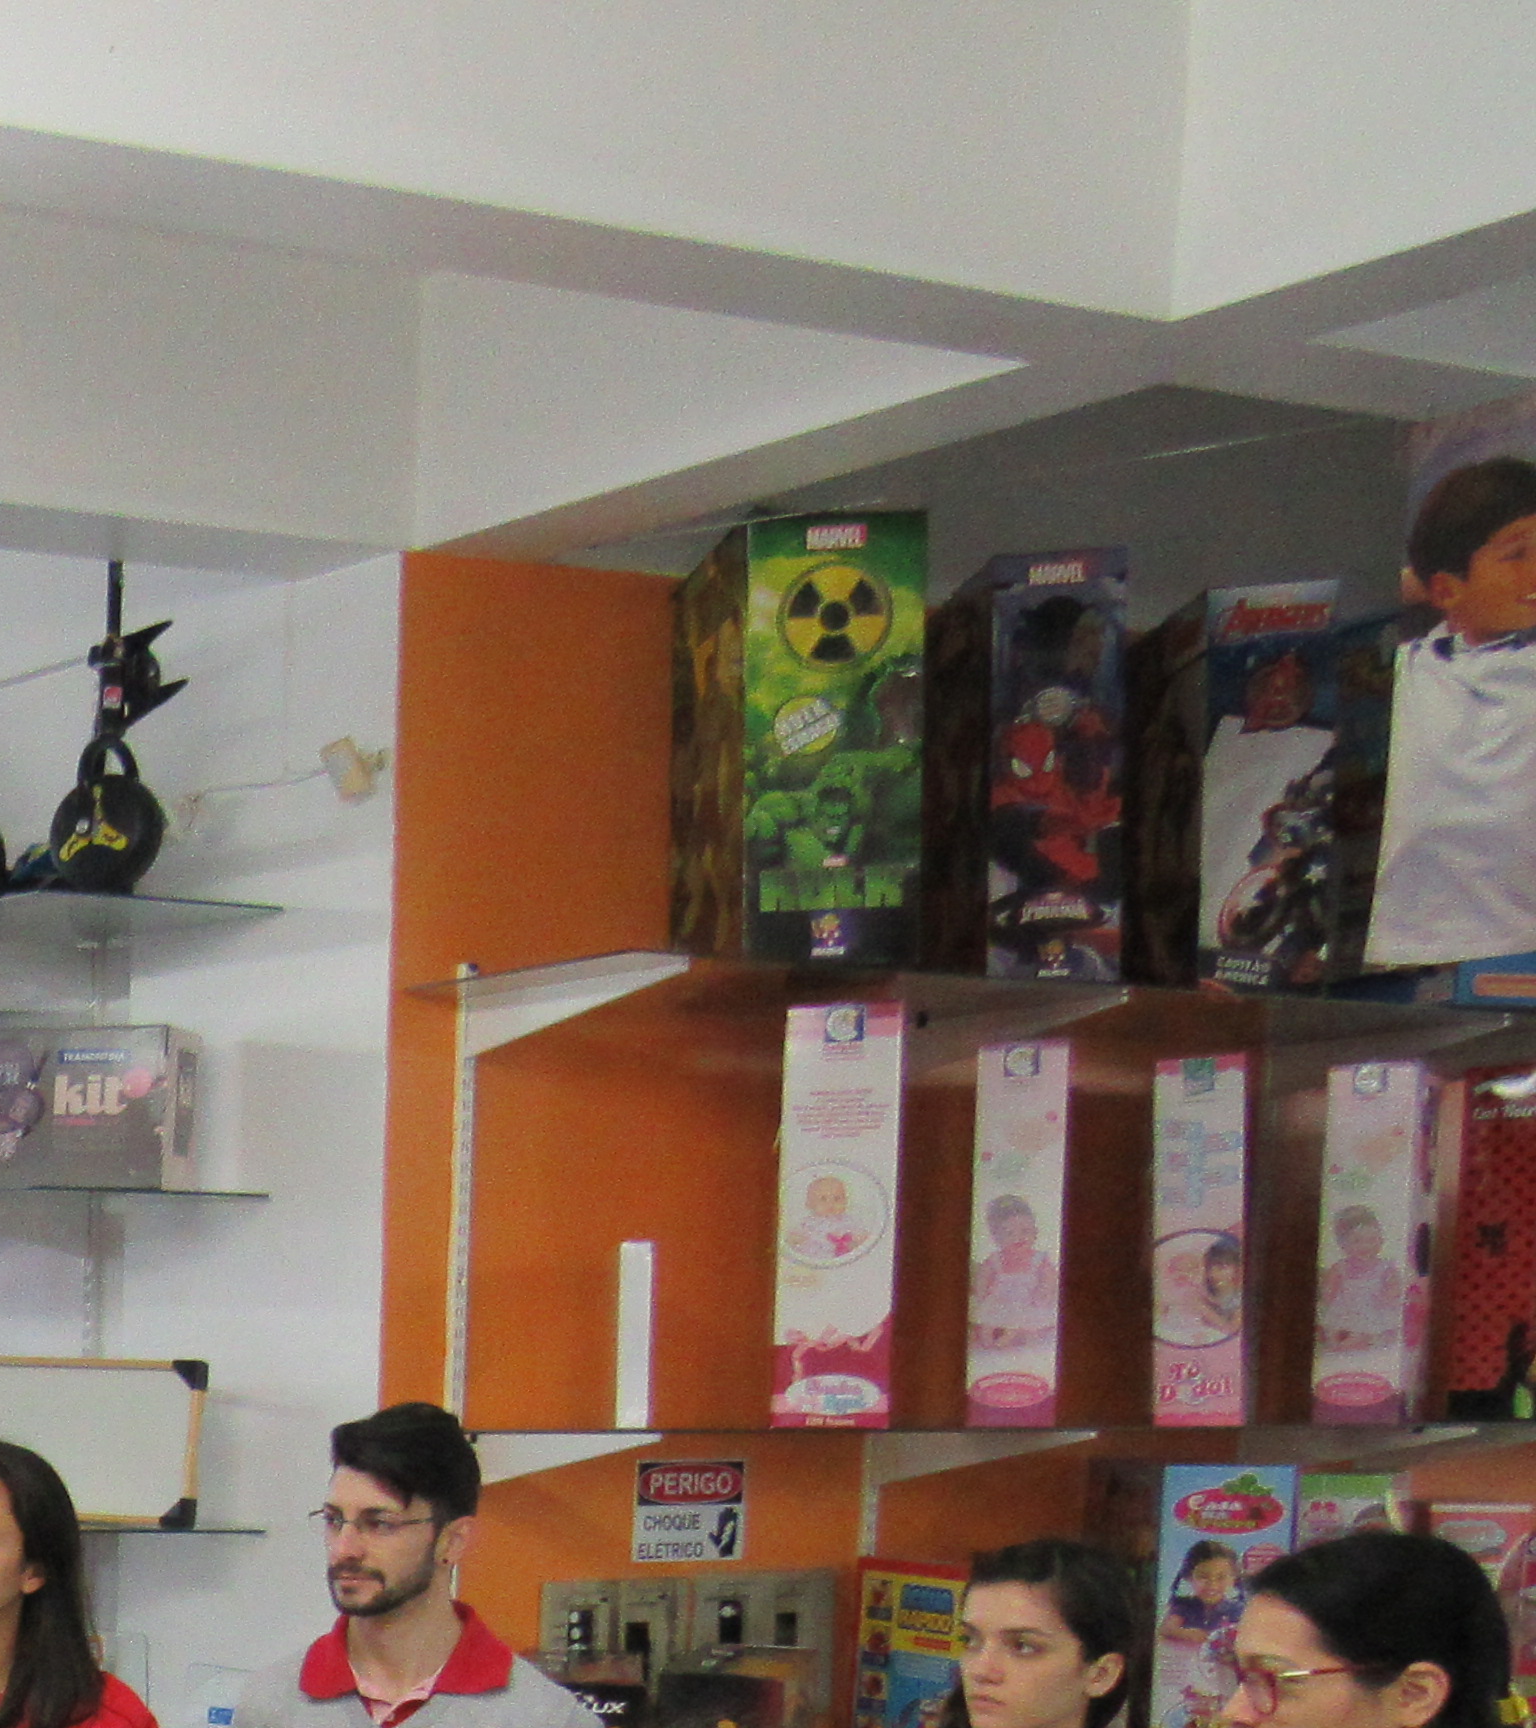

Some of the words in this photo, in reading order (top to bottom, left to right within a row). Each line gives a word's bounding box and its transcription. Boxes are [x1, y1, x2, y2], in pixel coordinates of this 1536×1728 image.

[53, 1073, 128, 1117] kit
[649, 1472, 733, 1495] PERIGO
[643, 1513, 701, 1531] CHOQUE
[638, 1539, 704, 1560] ELÉTRICO
